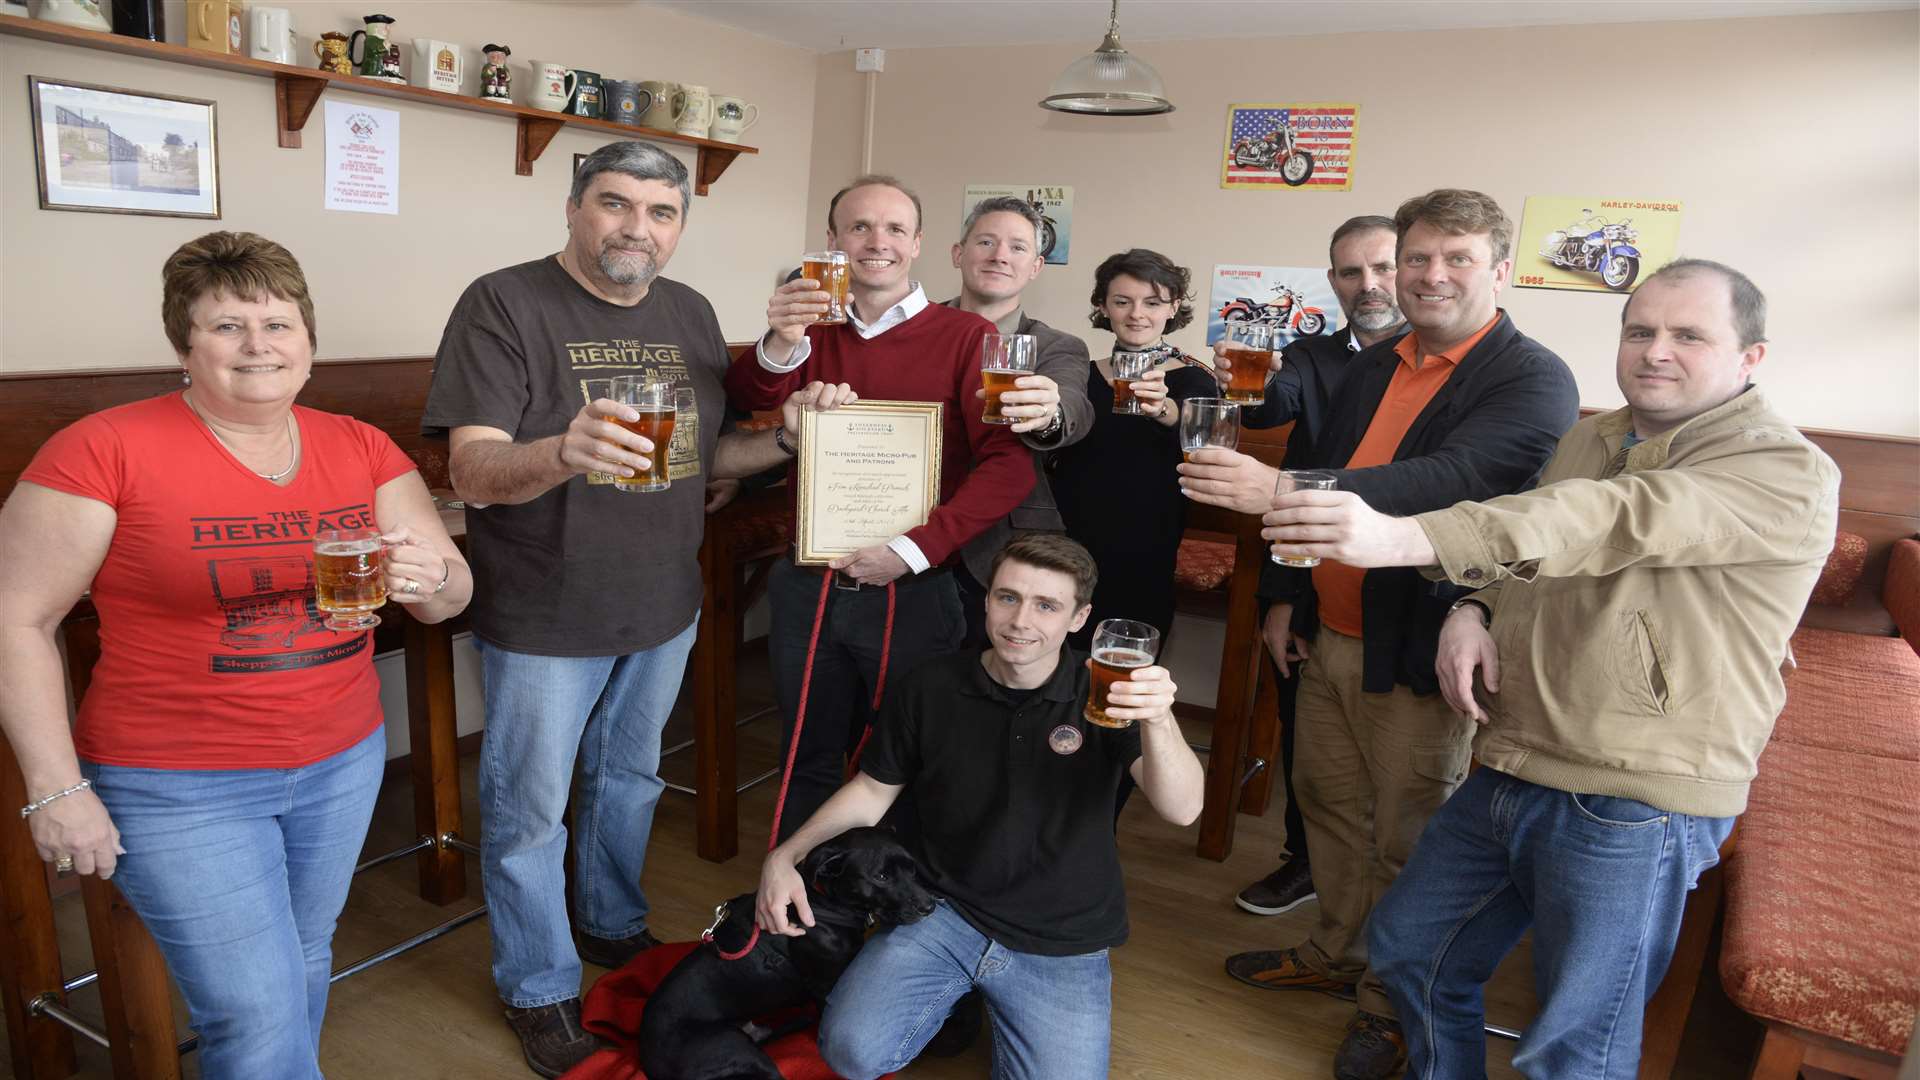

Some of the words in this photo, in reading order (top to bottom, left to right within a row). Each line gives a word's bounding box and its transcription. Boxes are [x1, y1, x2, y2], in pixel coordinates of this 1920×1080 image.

[1297, 116, 1349, 130] BORN
[1601, 202, 1679, 210] HARLEY-DAVIDSON
[1520, 275, 1545, 285] 1965
[611, 339, 641, 349] THE
[568, 348, 686, 363] HERITAGE
[267, 510, 313, 522] THE
[192, 511, 376, 542] HERITAGE
